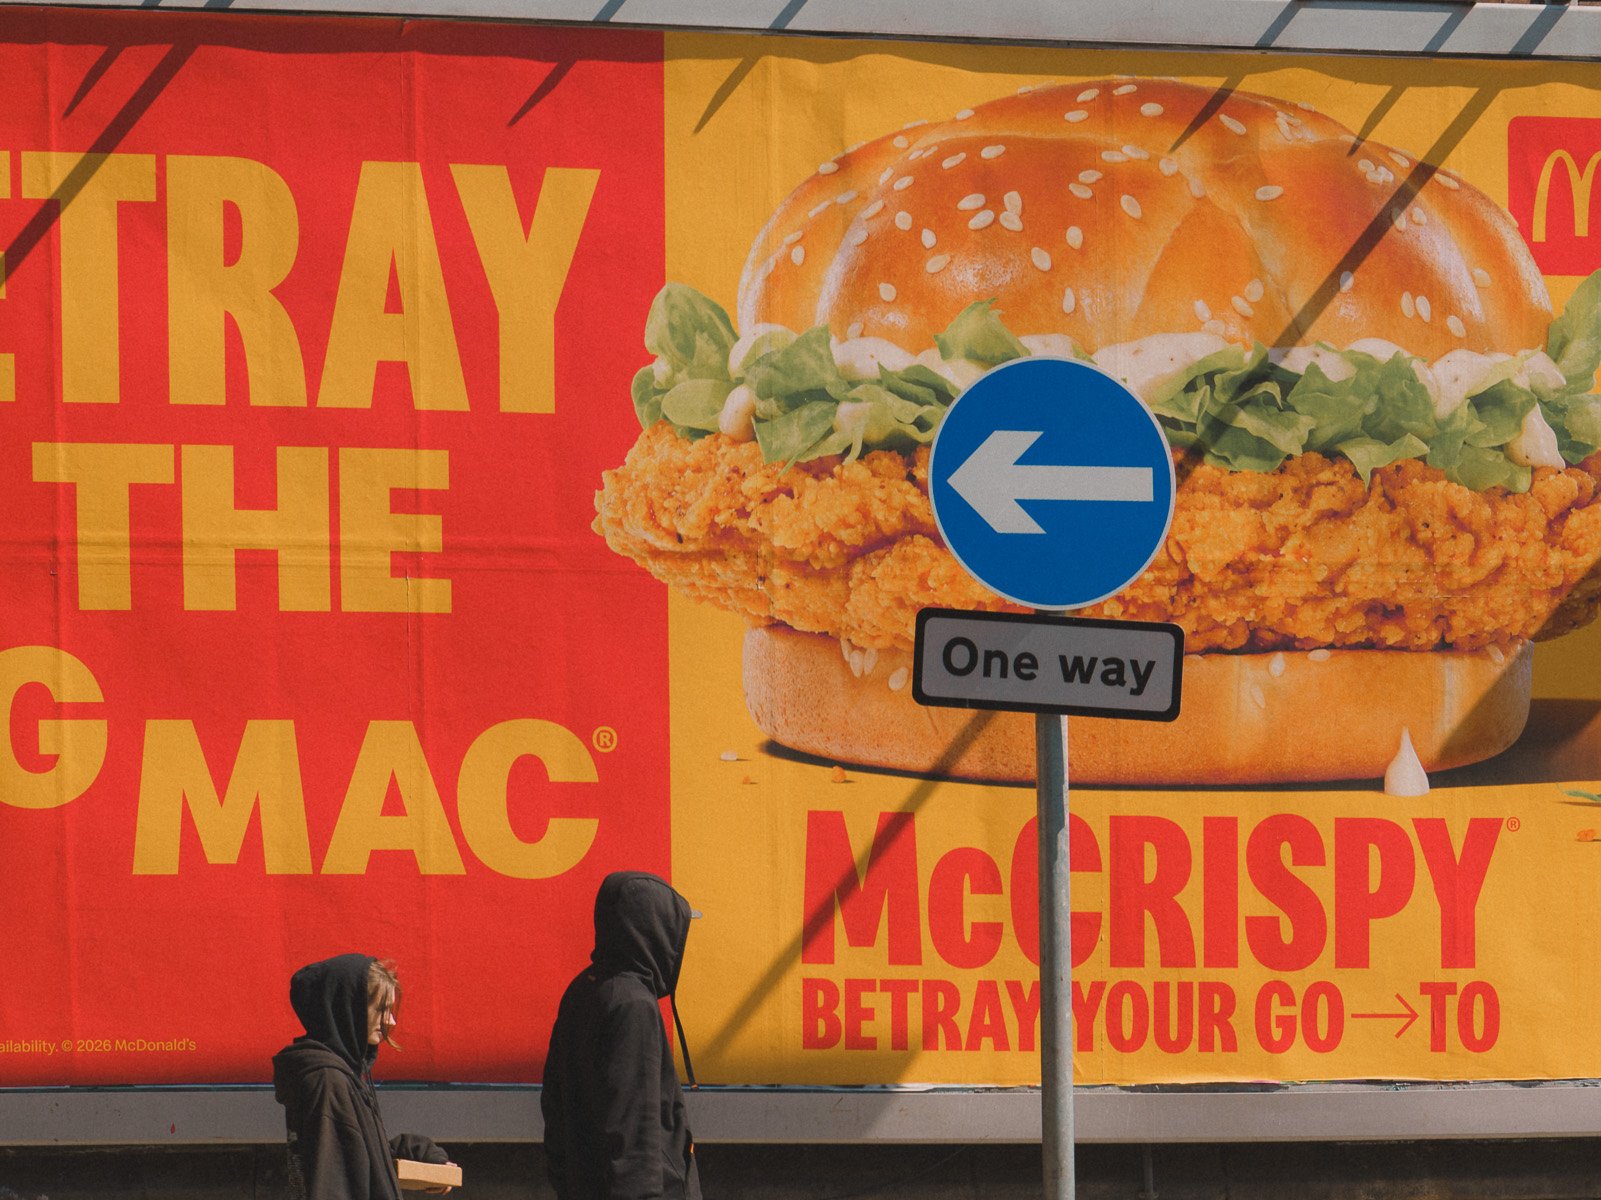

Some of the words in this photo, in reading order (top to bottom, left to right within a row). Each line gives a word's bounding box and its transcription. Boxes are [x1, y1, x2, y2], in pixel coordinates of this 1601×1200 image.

[0, 150, 601, 414] TRAY
[31, 442, 452, 614] THE
[942, 636, 1039, 681] One
[1058, 654, 1156, 697] way
[77, 1039, 112, 1052] 2026
[801, 978, 1041, 1053] BETRAY
[1071, 979, 1238, 1053] YOUR
[1254, 980, 1345, 1054] GO
[1420, 981, 1501, 1053] TO
